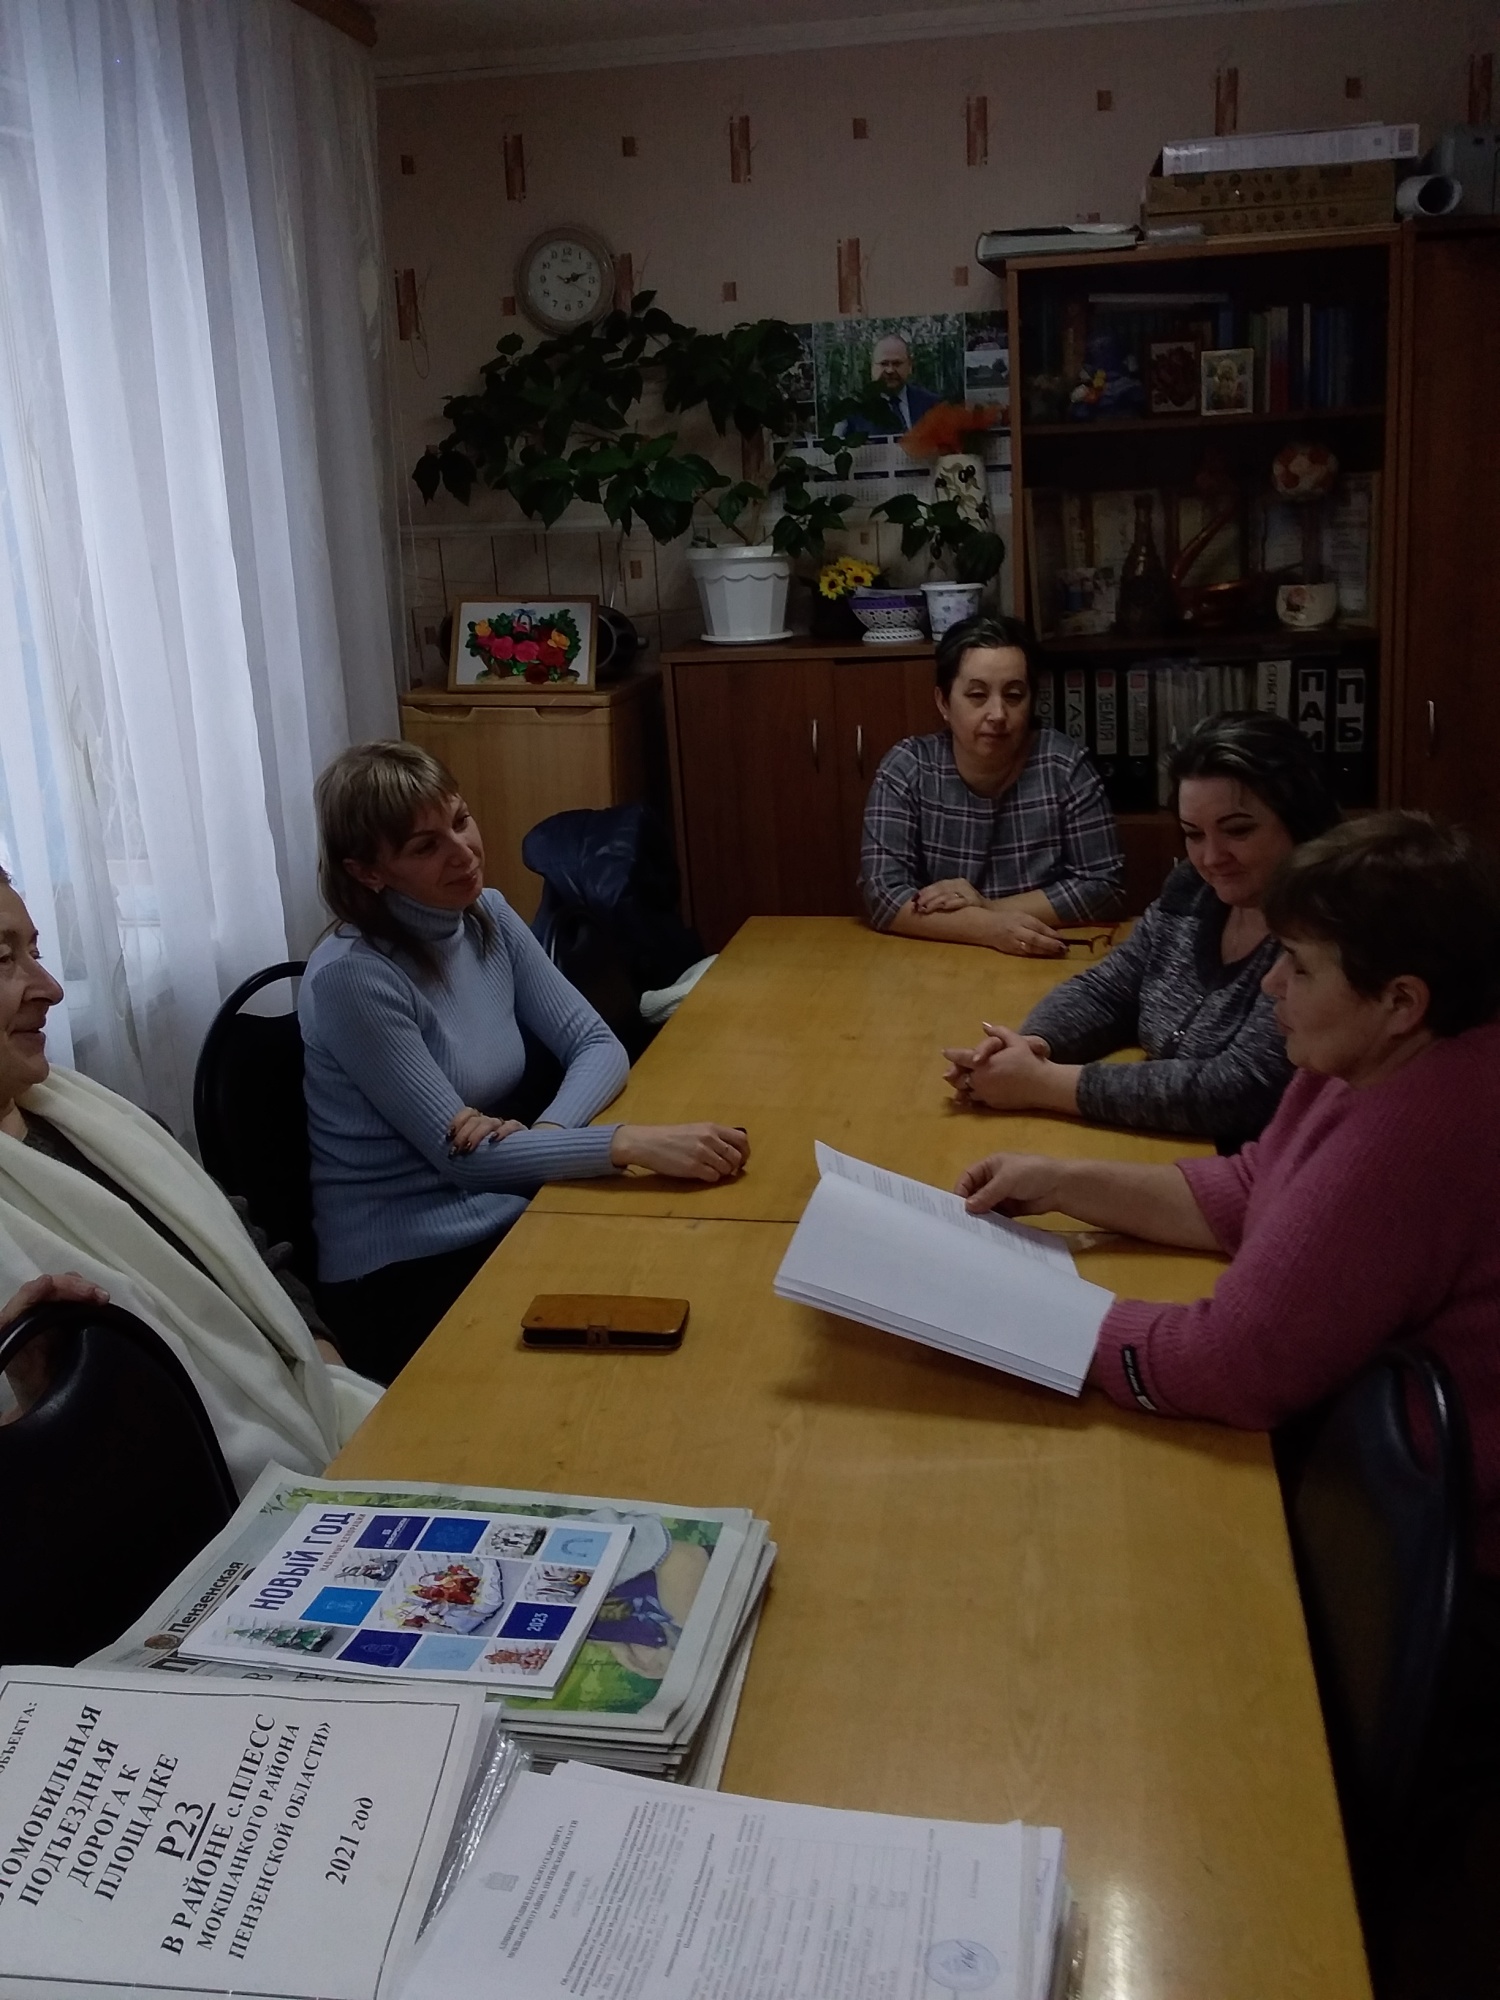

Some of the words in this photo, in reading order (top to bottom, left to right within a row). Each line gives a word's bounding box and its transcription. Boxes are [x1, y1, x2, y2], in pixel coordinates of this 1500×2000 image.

[1068, 690, 1083, 738] ГАЗ
[1099, 693, 1114, 741] ЗЕМЛЯ
[249, 1550, 324, 1611] НОВЫЙ
[303, 1512, 356, 1545] ГОД
[320, 1543, 345, 1571] НАДУВНЫЕ
[341, 1513, 367, 1544] ДЕКОРАЦИИ
[167, 1561, 244, 1633] Пензенская
[526, 1610, 549, 1633] 2023
[0, 1705, 102, 1906] ТОМОБИЛЬНАЯ
[19, 1739, 119, 1906] ПОДЪЕЗДНАЯ
[67, 1784, 132, 1888] ДОРОГА
[123, 1764, 142, 1784] К
[93, 1753, 179, 1902] ПЛОЩАДКЕ
[156, 1802, 204, 1863] Р23
[161, 1935, 184, 1956] В
[177, 1824, 234, 1927] РАЙОНЕ
[227, 1713, 277, 1819] с.ПЛЕСС
[196, 1804, 269, 1951] МОКШАНКОГО
[260, 1723, 301, 1801] РАЙОНА
[228, 1820, 295, 1961] ПЕНЗЕНСКОЙ
[287, 1721, 333, 1819] ОБЛАСТИ»
[325, 1834, 361, 1886] 2021
[351, 1796, 374, 1832] год
